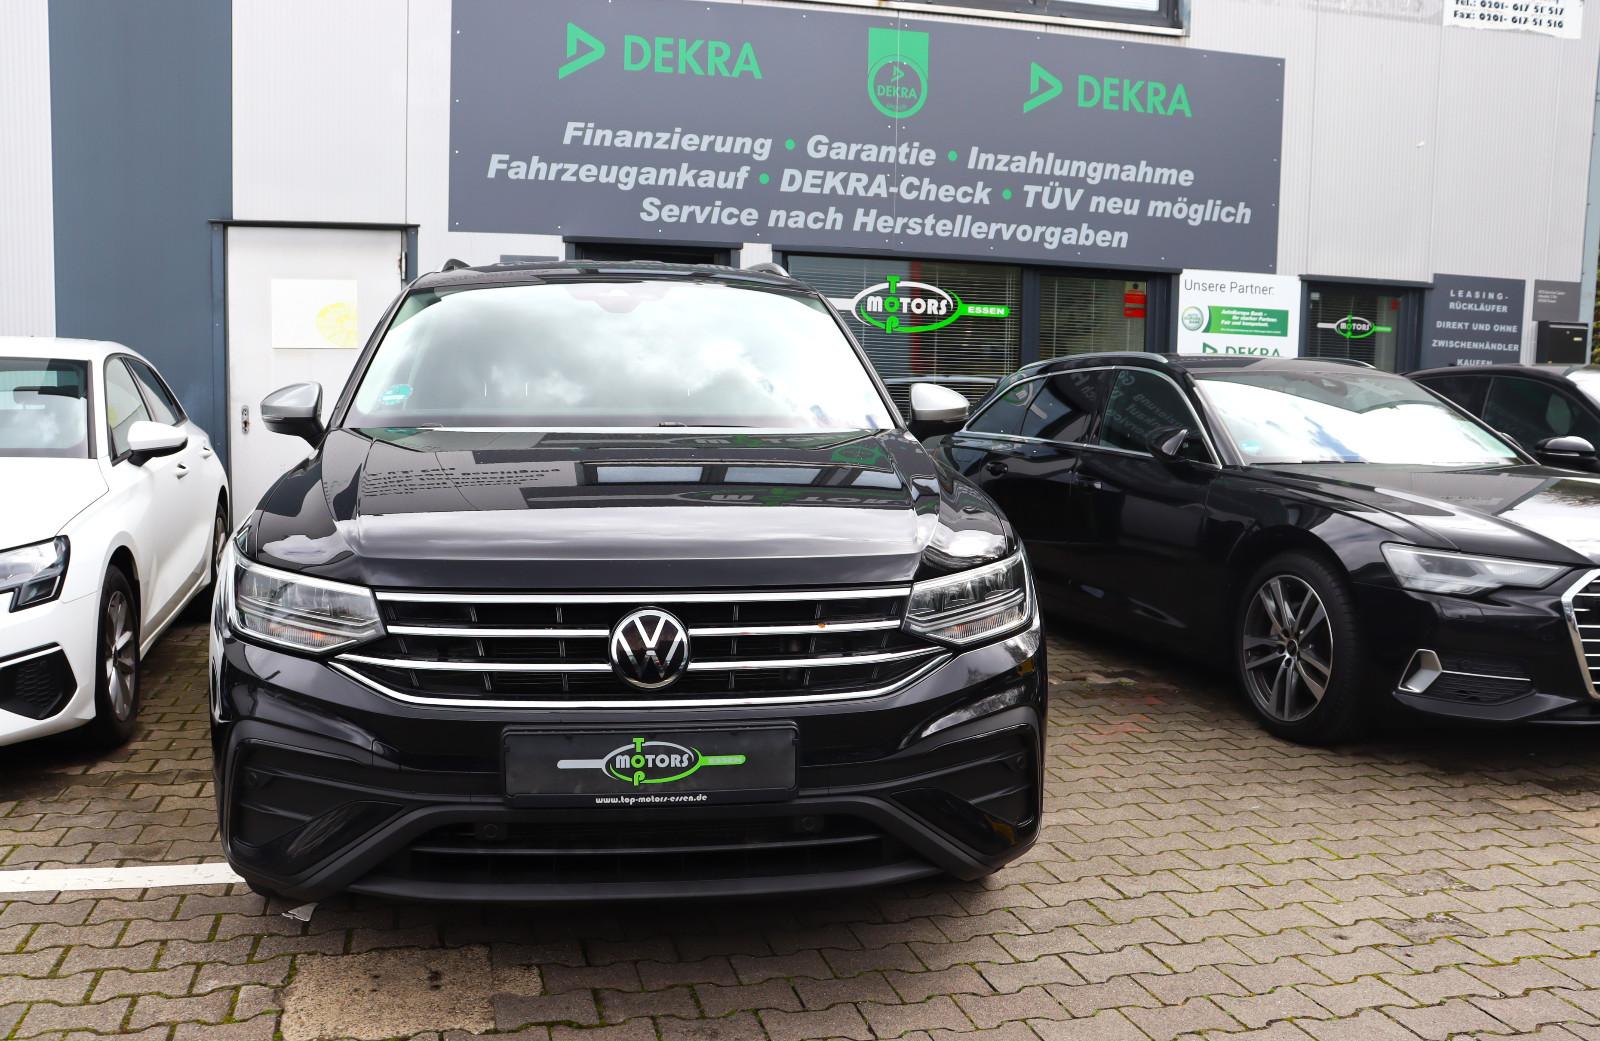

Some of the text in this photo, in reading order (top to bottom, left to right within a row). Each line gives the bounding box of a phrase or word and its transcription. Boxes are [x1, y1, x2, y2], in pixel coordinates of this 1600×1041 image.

[1453, 10, 1476, 20] Fax:
[623, 34, 763, 80] DEKRA
[877, 84, 917, 100] DEKRA
[1077, 74, 1193, 118] DEKRA
[562, 121, 1195, 188] Finanzierung Garantie Inzahlungnahme
[487, 153, 1252, 226] Fahrzeugankauf DEKRA-Check TÜV neu möglich
[639, 196, 1129, 250] Service nach Herstellervorgaben
[1184, 279, 1226, 293] Unsere
[1450, 289, 1509, 300] LEASING-
[866, 295, 949, 316] MOTORS
[967, 306, 1005, 316] ESSEN
[1449, 301, 1508, 313] RÜCKLÄUFER
[1436, 320, 1519, 333] DIREKT UND OHNE
[1432, 338, 1520, 352] ZWISCHENHÄNDLER
[615, 754, 690, 768] MOTORS
[595, 794, 708, 805] www.top-motors-essen.de
